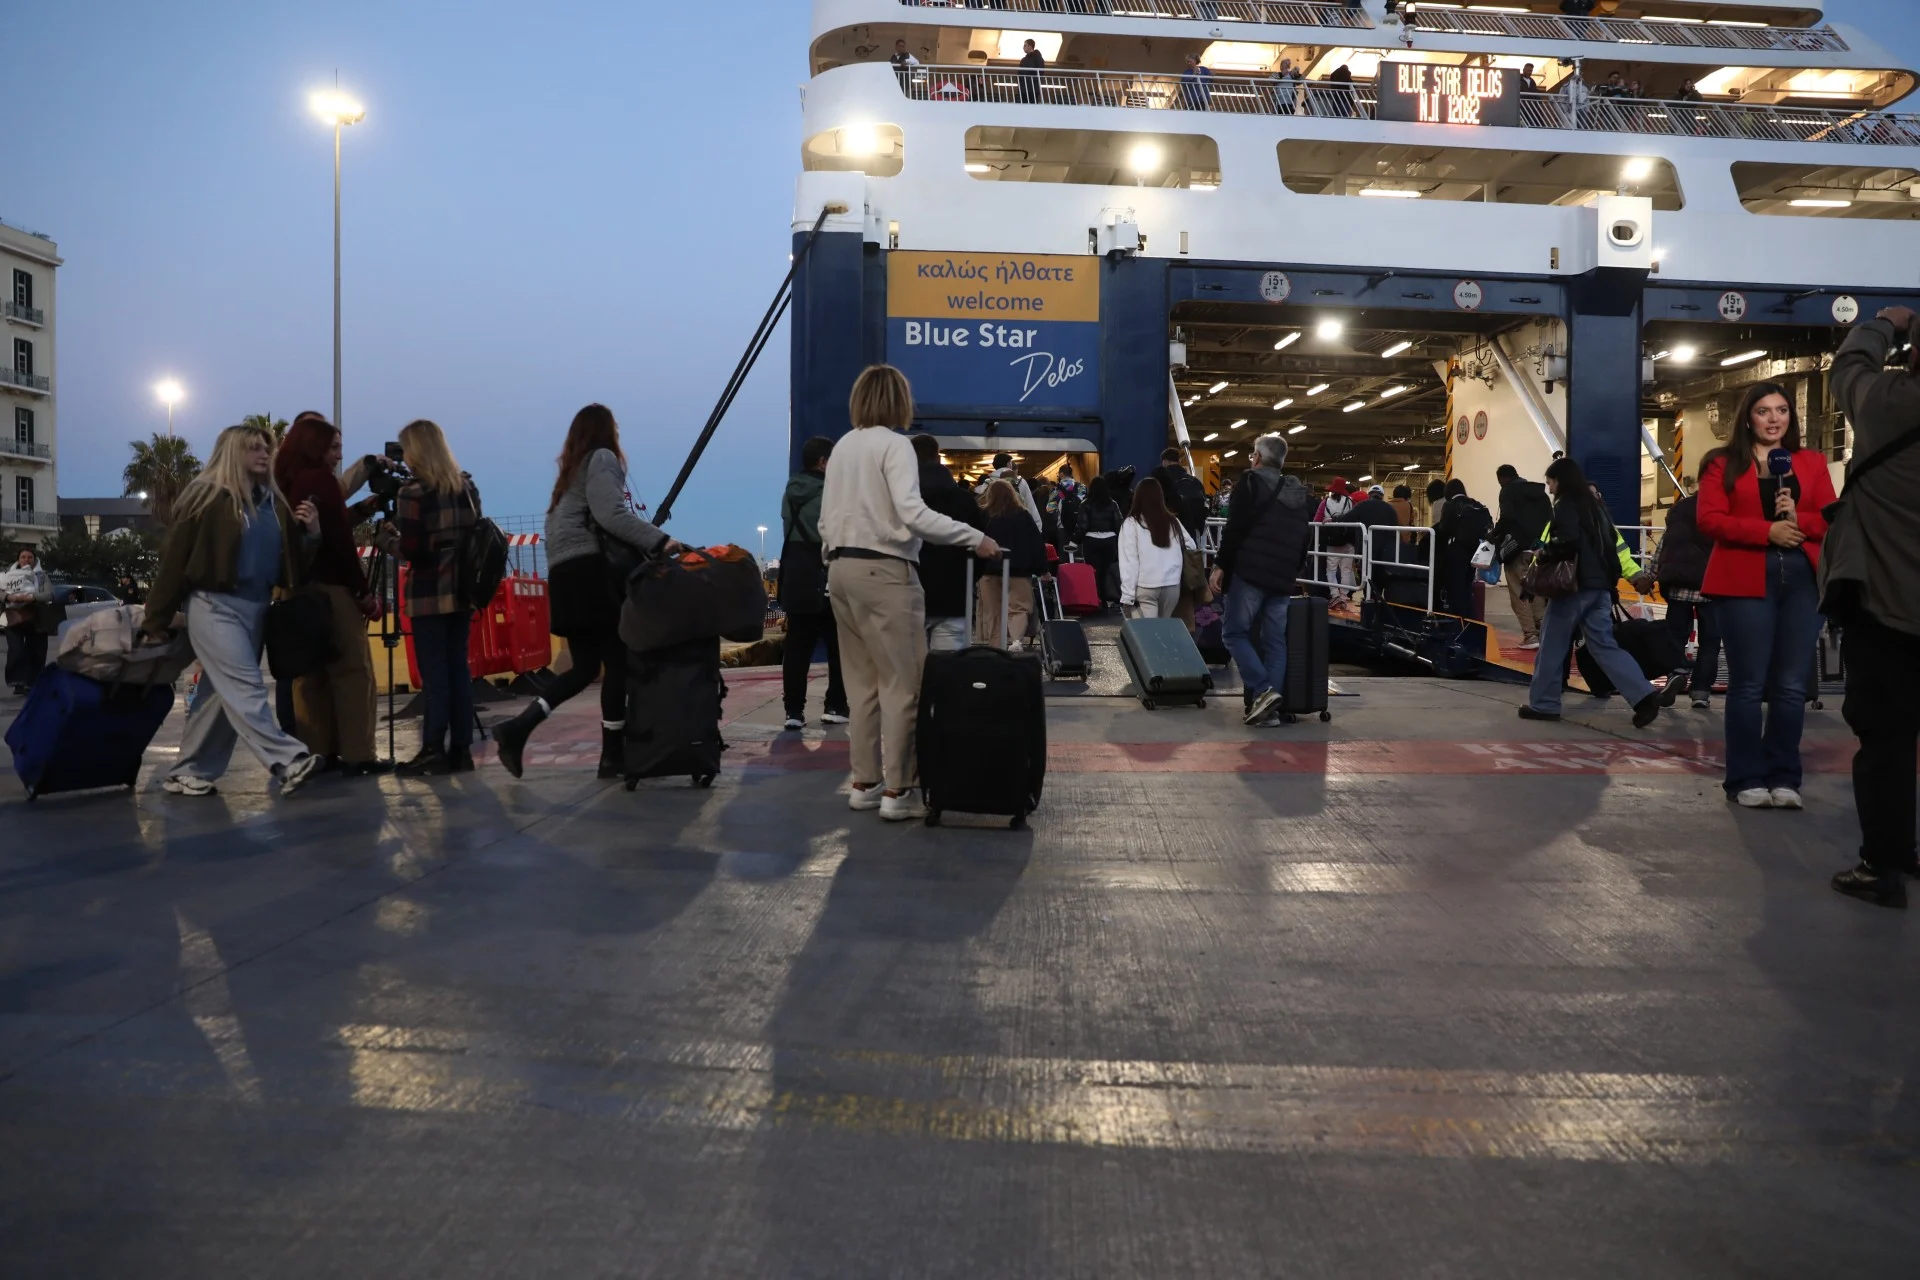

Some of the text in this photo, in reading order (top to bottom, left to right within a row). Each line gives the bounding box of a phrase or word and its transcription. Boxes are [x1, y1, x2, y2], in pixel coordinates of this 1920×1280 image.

[1398, 64, 1503, 98] BLUE STAR DELOS
[917, 259, 1074, 284] καλώς ήλθατε
[947, 291, 1044, 311] welcome
[905, 321, 1038, 348] Blue Star
[1009, 351, 1084, 402] Delos
